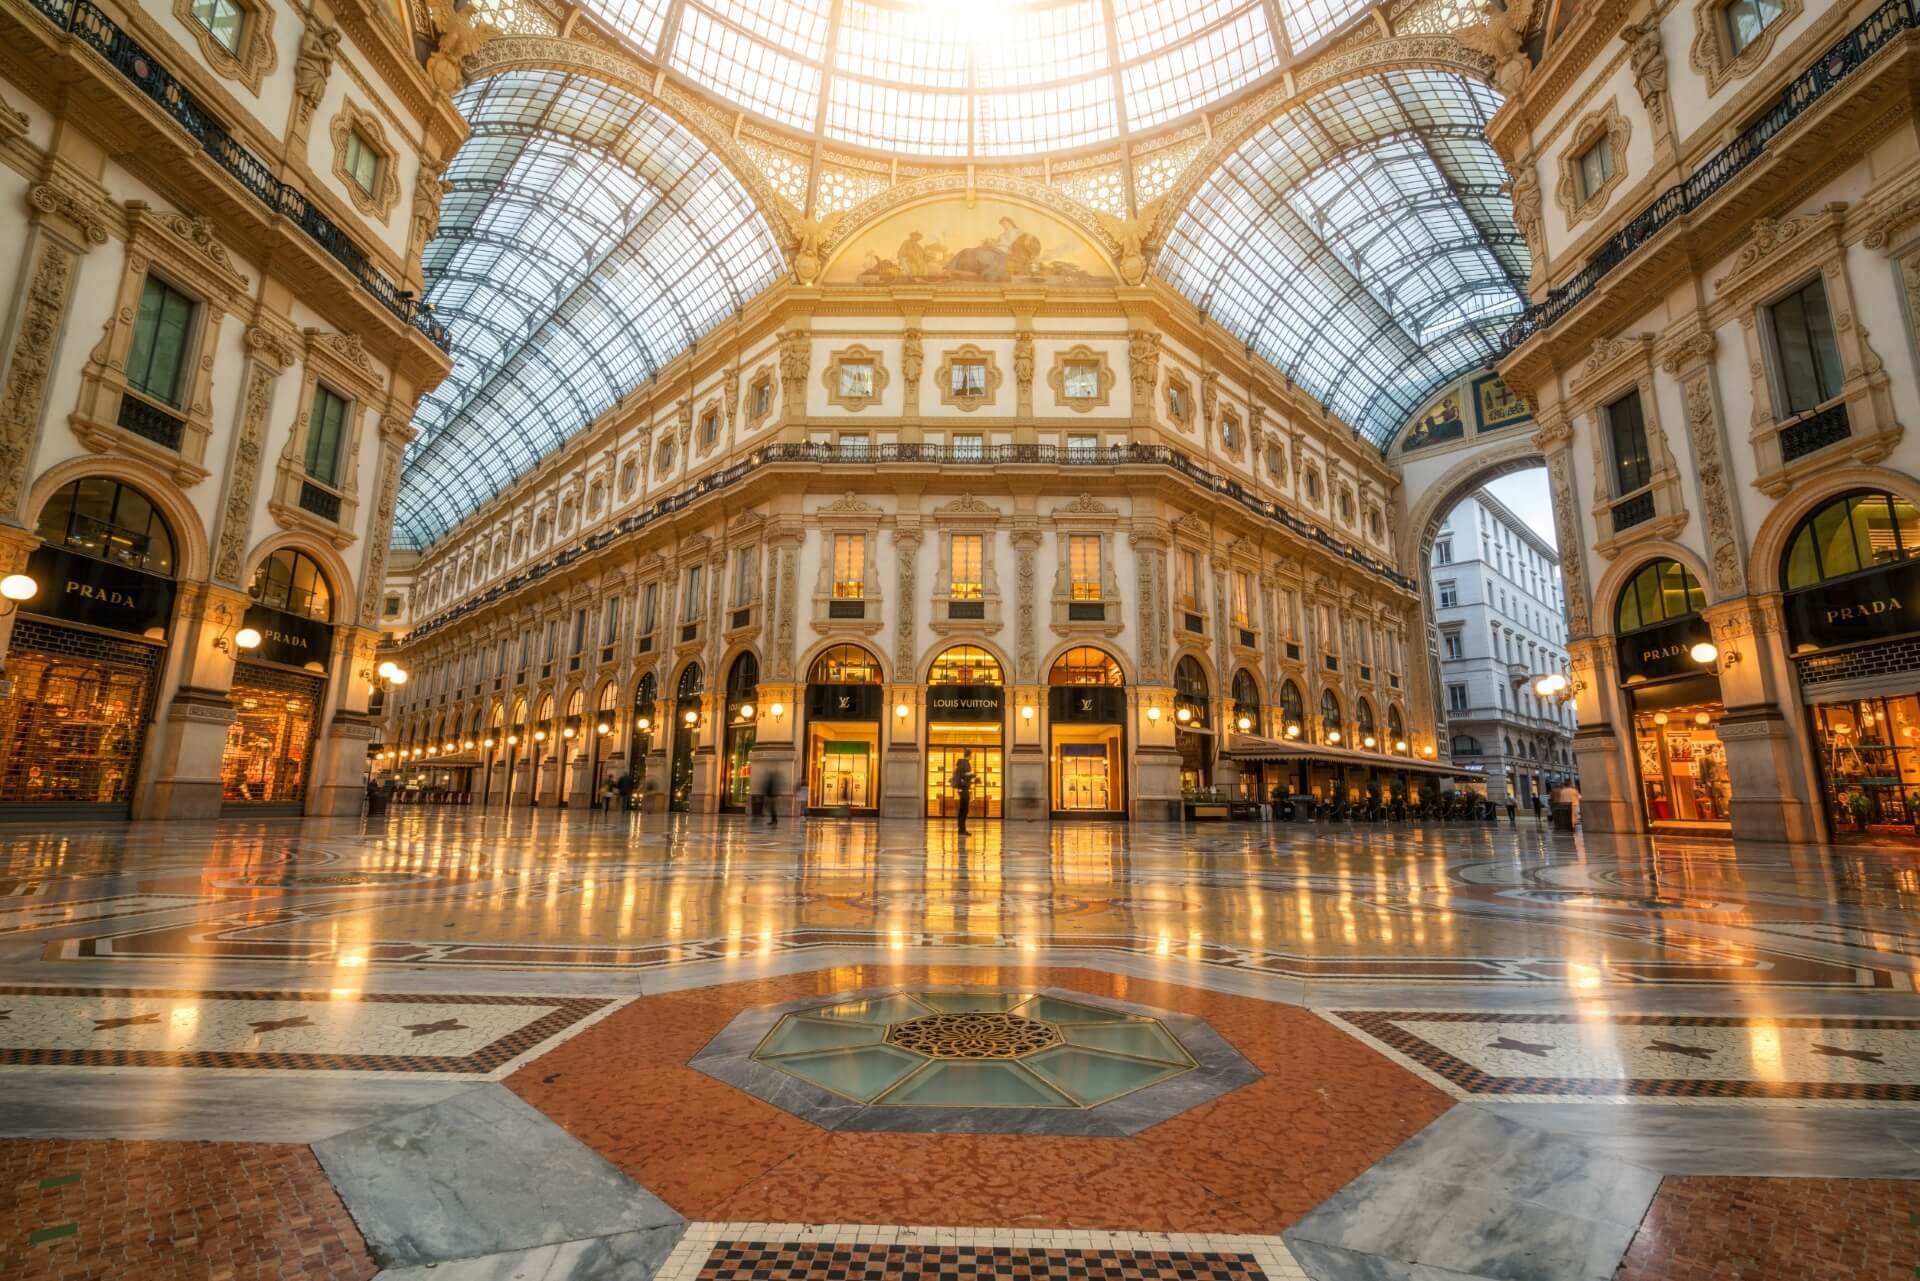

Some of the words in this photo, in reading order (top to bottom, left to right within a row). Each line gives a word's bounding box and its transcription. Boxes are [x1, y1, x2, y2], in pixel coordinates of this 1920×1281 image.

[66, 581, 136, 609] PRADA
[1826, 597, 1903, 623] PRADA
[264, 629, 308, 649] PRADA
[1643, 643, 1690, 662] PRADA
[933, 699, 959, 708] LOUIS
[960, 699, 998, 708] VUITTON
